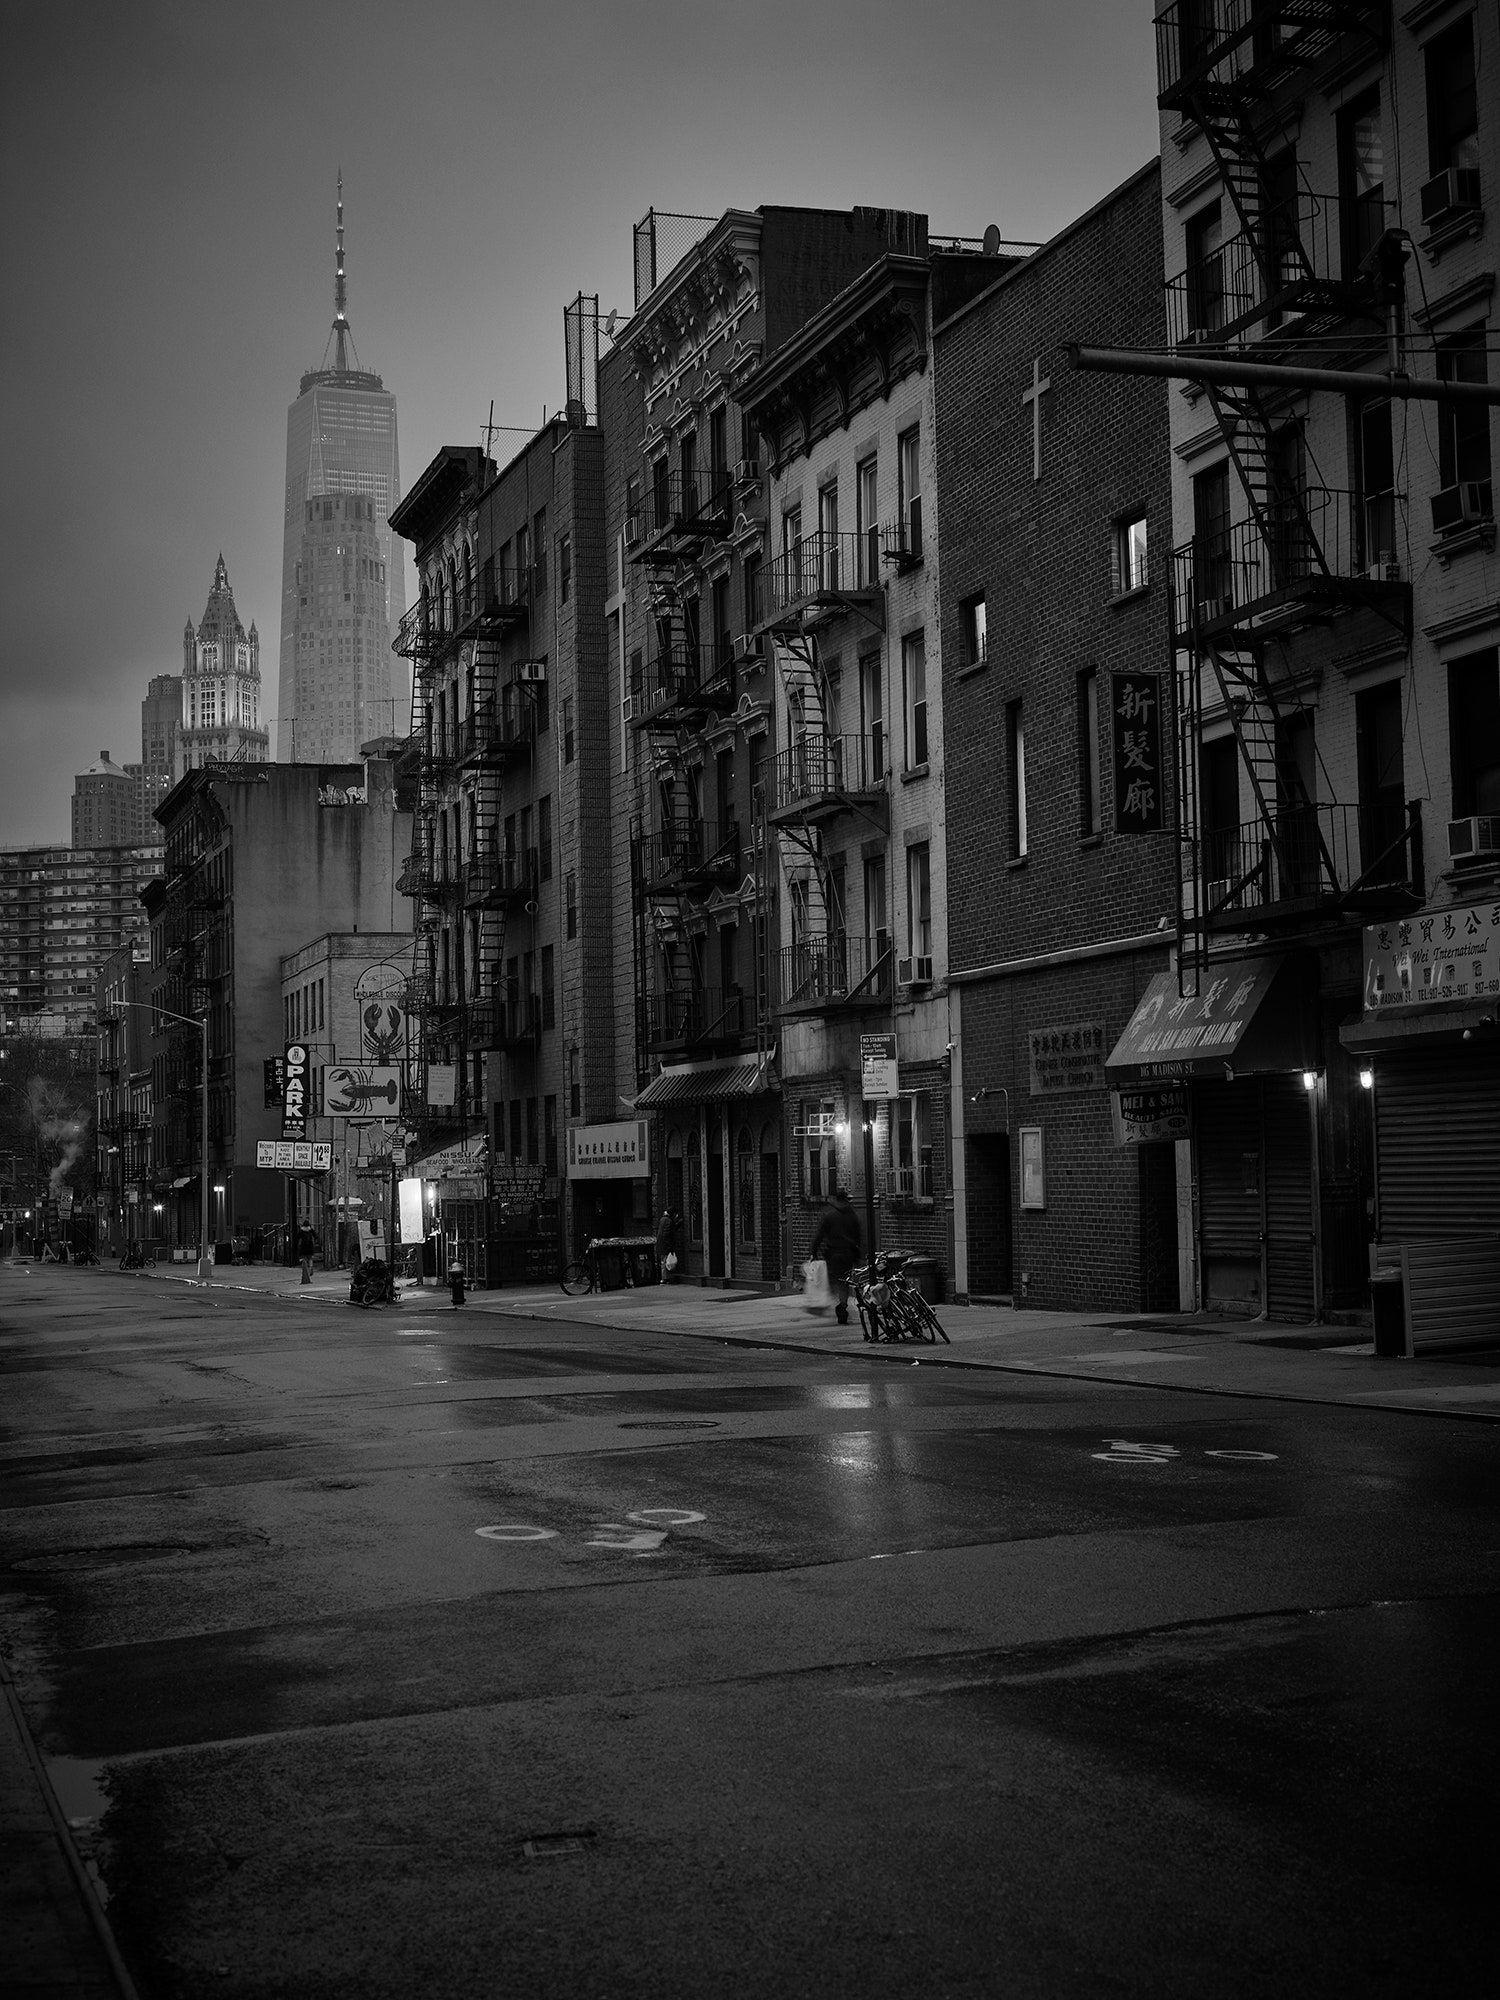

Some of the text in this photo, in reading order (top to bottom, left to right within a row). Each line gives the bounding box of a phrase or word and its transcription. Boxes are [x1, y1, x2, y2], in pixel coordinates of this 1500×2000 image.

[1115, 682, 1156, 821] 新髮廊
[1412, 948, 1429, 964] Wei
[1433, 936, 1490, 961] International
[1152, 1061, 1183, 1077] MADISON
[286, 1064, 304, 1117] PARK
[1122, 1092, 1184, 1110] MEI & SAM
